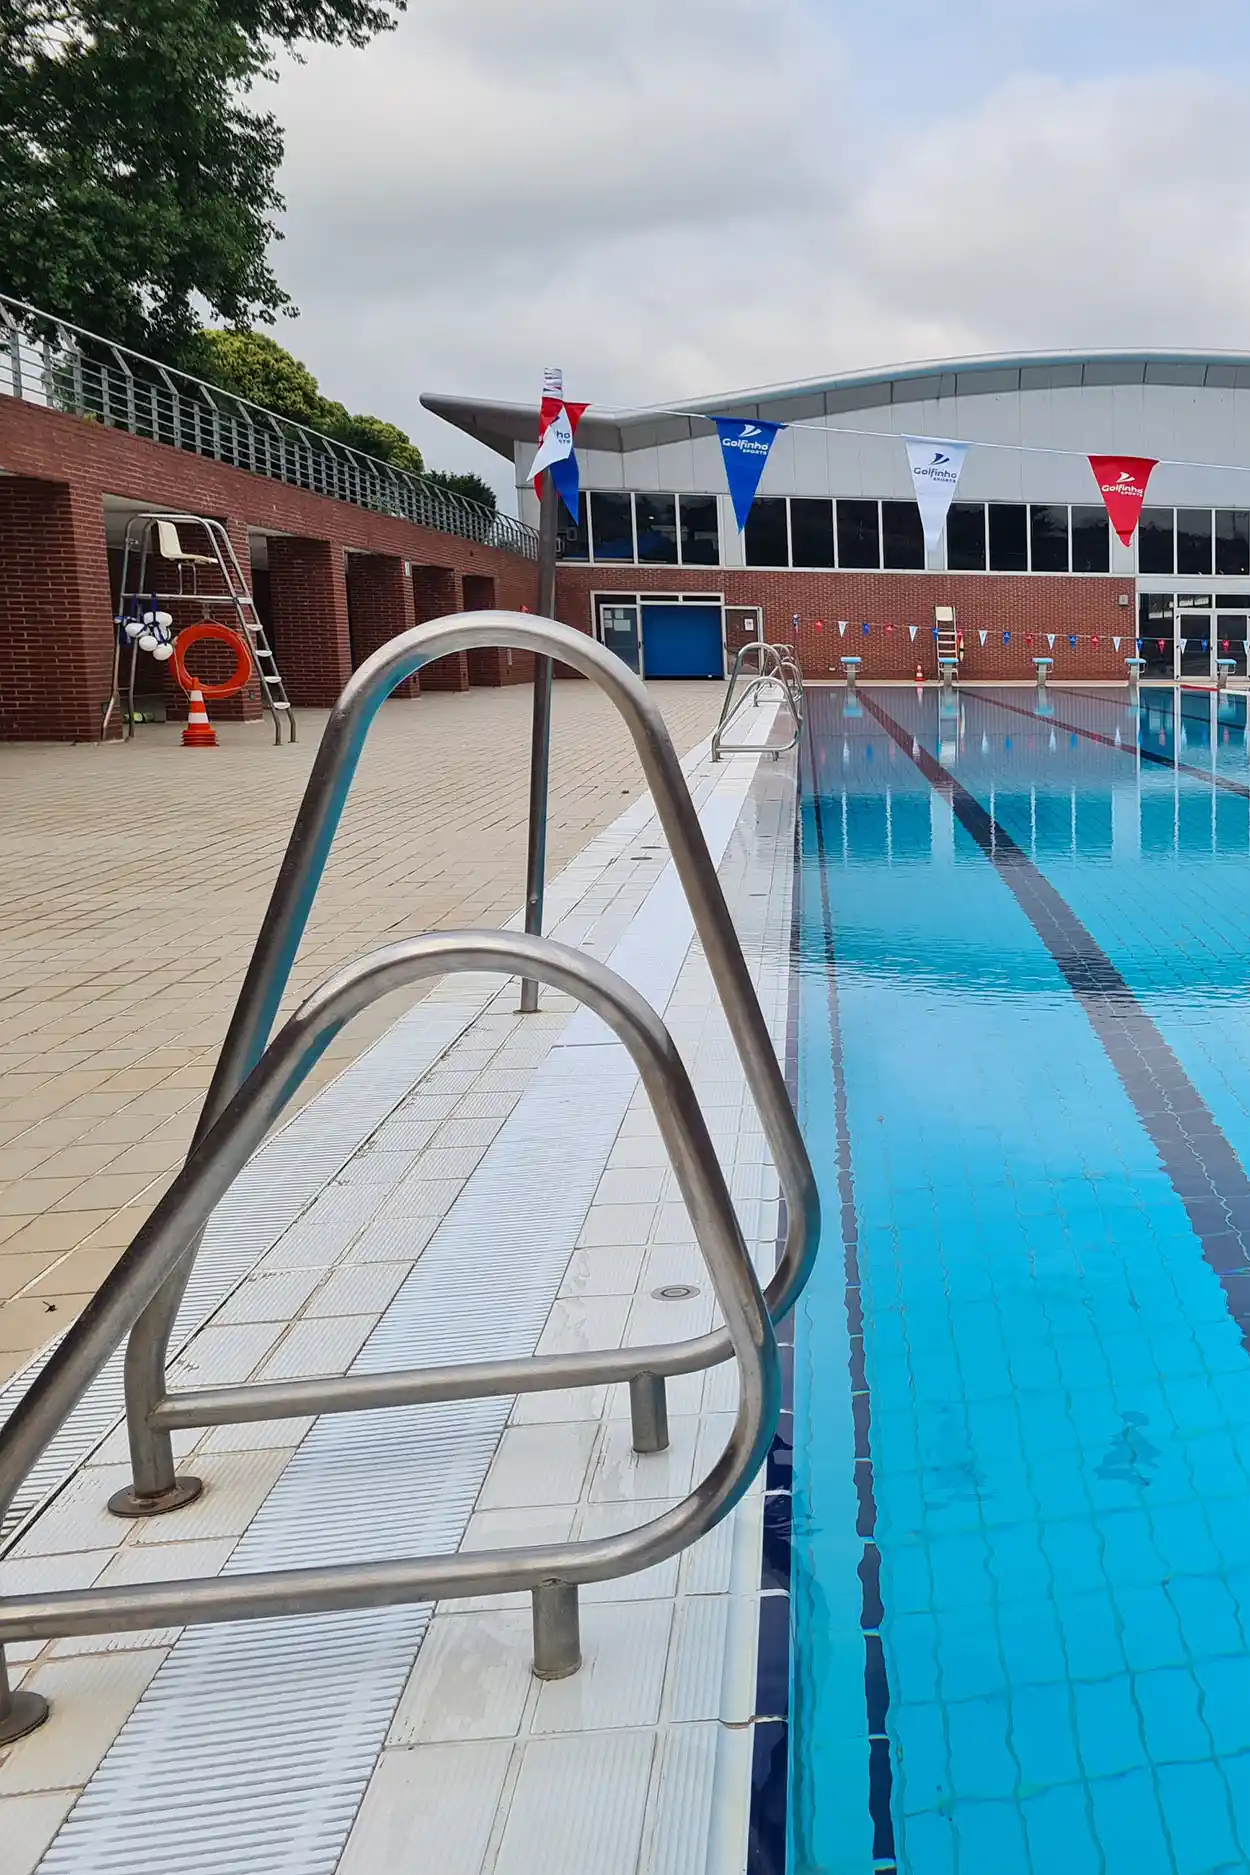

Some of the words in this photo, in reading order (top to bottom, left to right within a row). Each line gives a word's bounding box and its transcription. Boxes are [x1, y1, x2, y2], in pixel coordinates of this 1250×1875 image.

[722, 438, 769, 450] Golfinho
[913, 467, 958, 479] Golfinho
[1101, 484, 1143, 493] Golfinho
